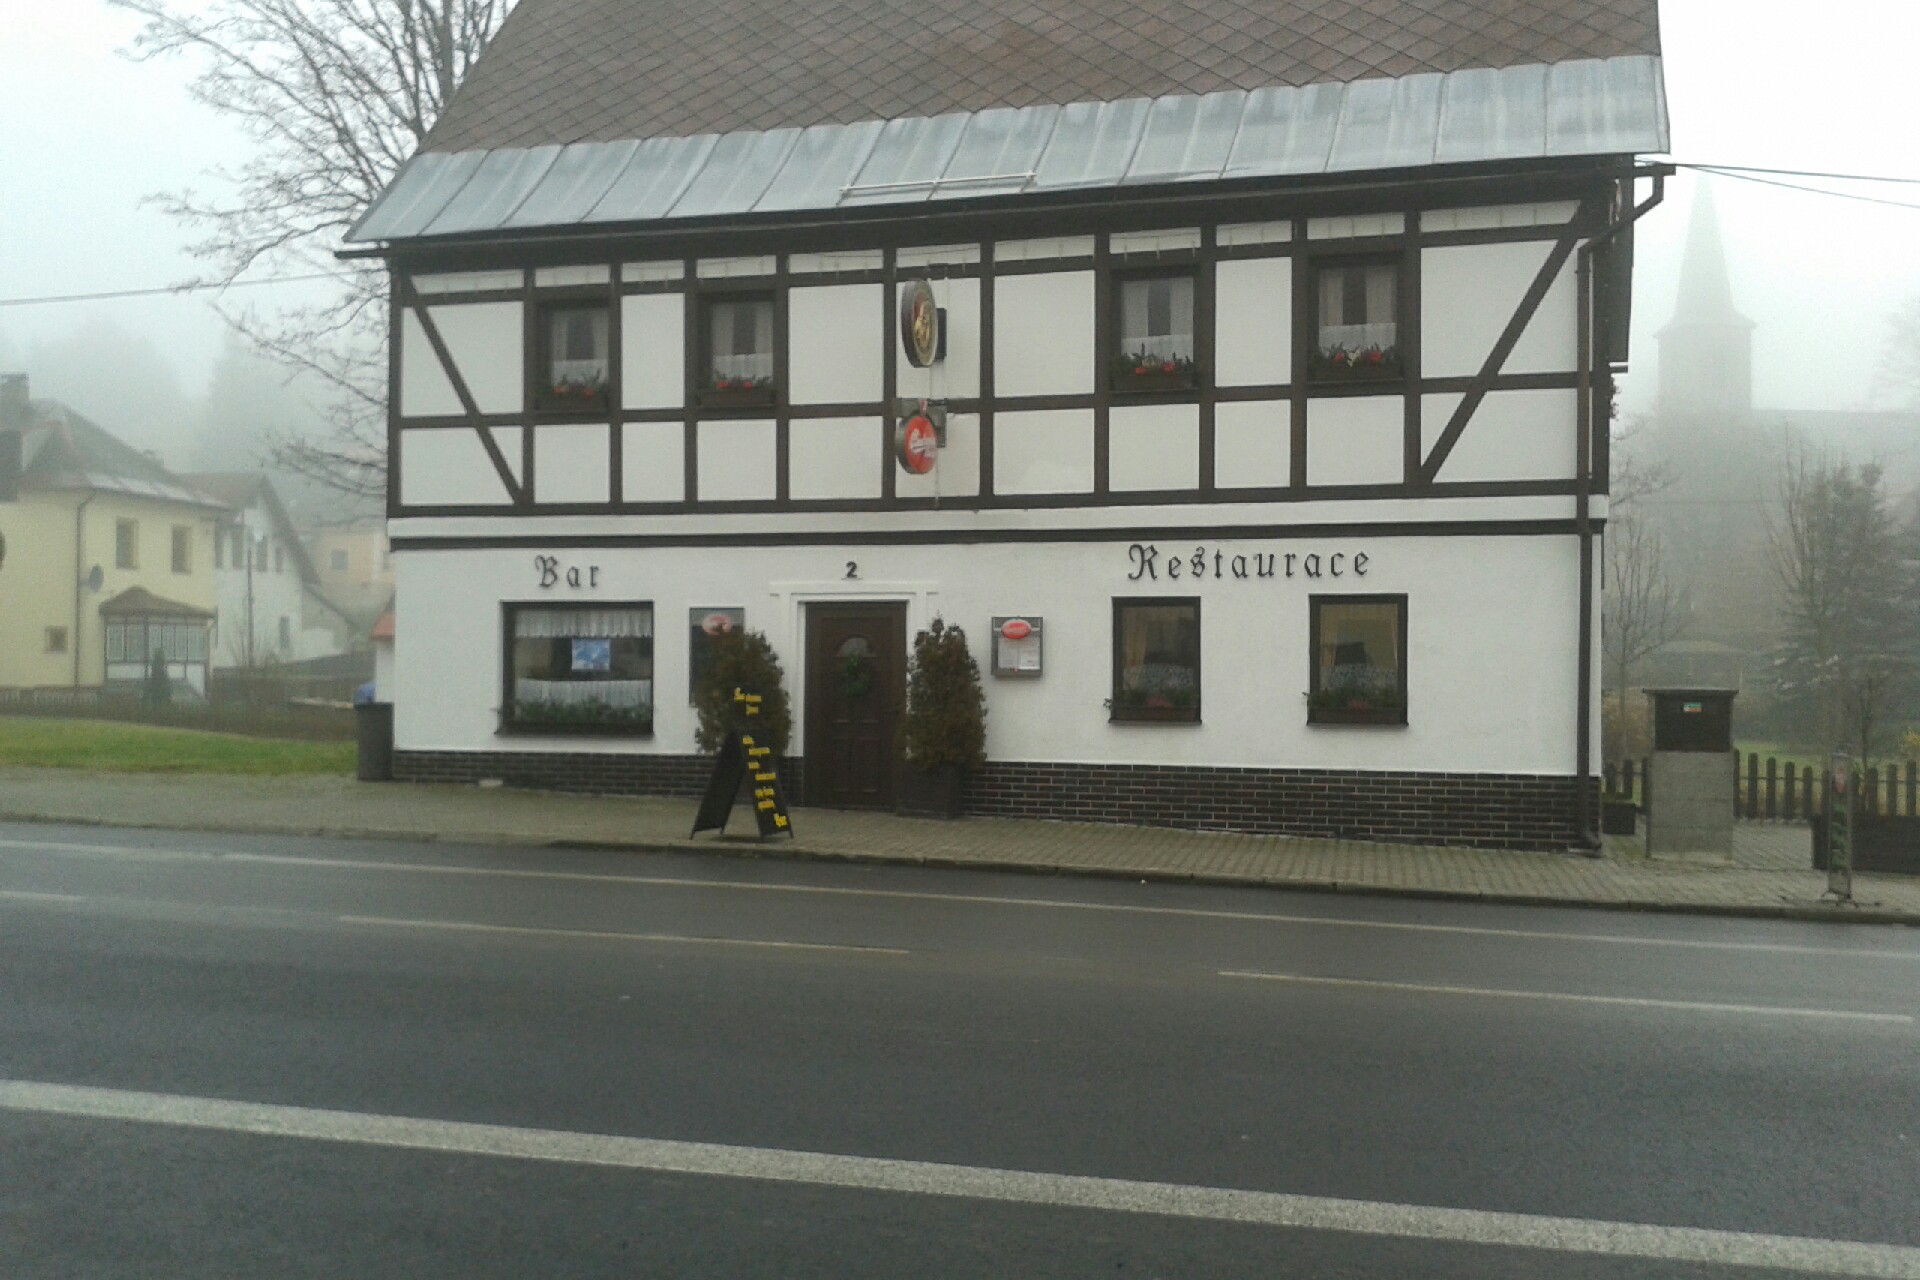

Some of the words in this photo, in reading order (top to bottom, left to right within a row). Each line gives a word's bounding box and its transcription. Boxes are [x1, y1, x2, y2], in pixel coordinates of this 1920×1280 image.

[534, 554, 600, 588] Bar
[845, 560, 858, 579] 2
[1127, 543, 1370, 581] Restaurace
